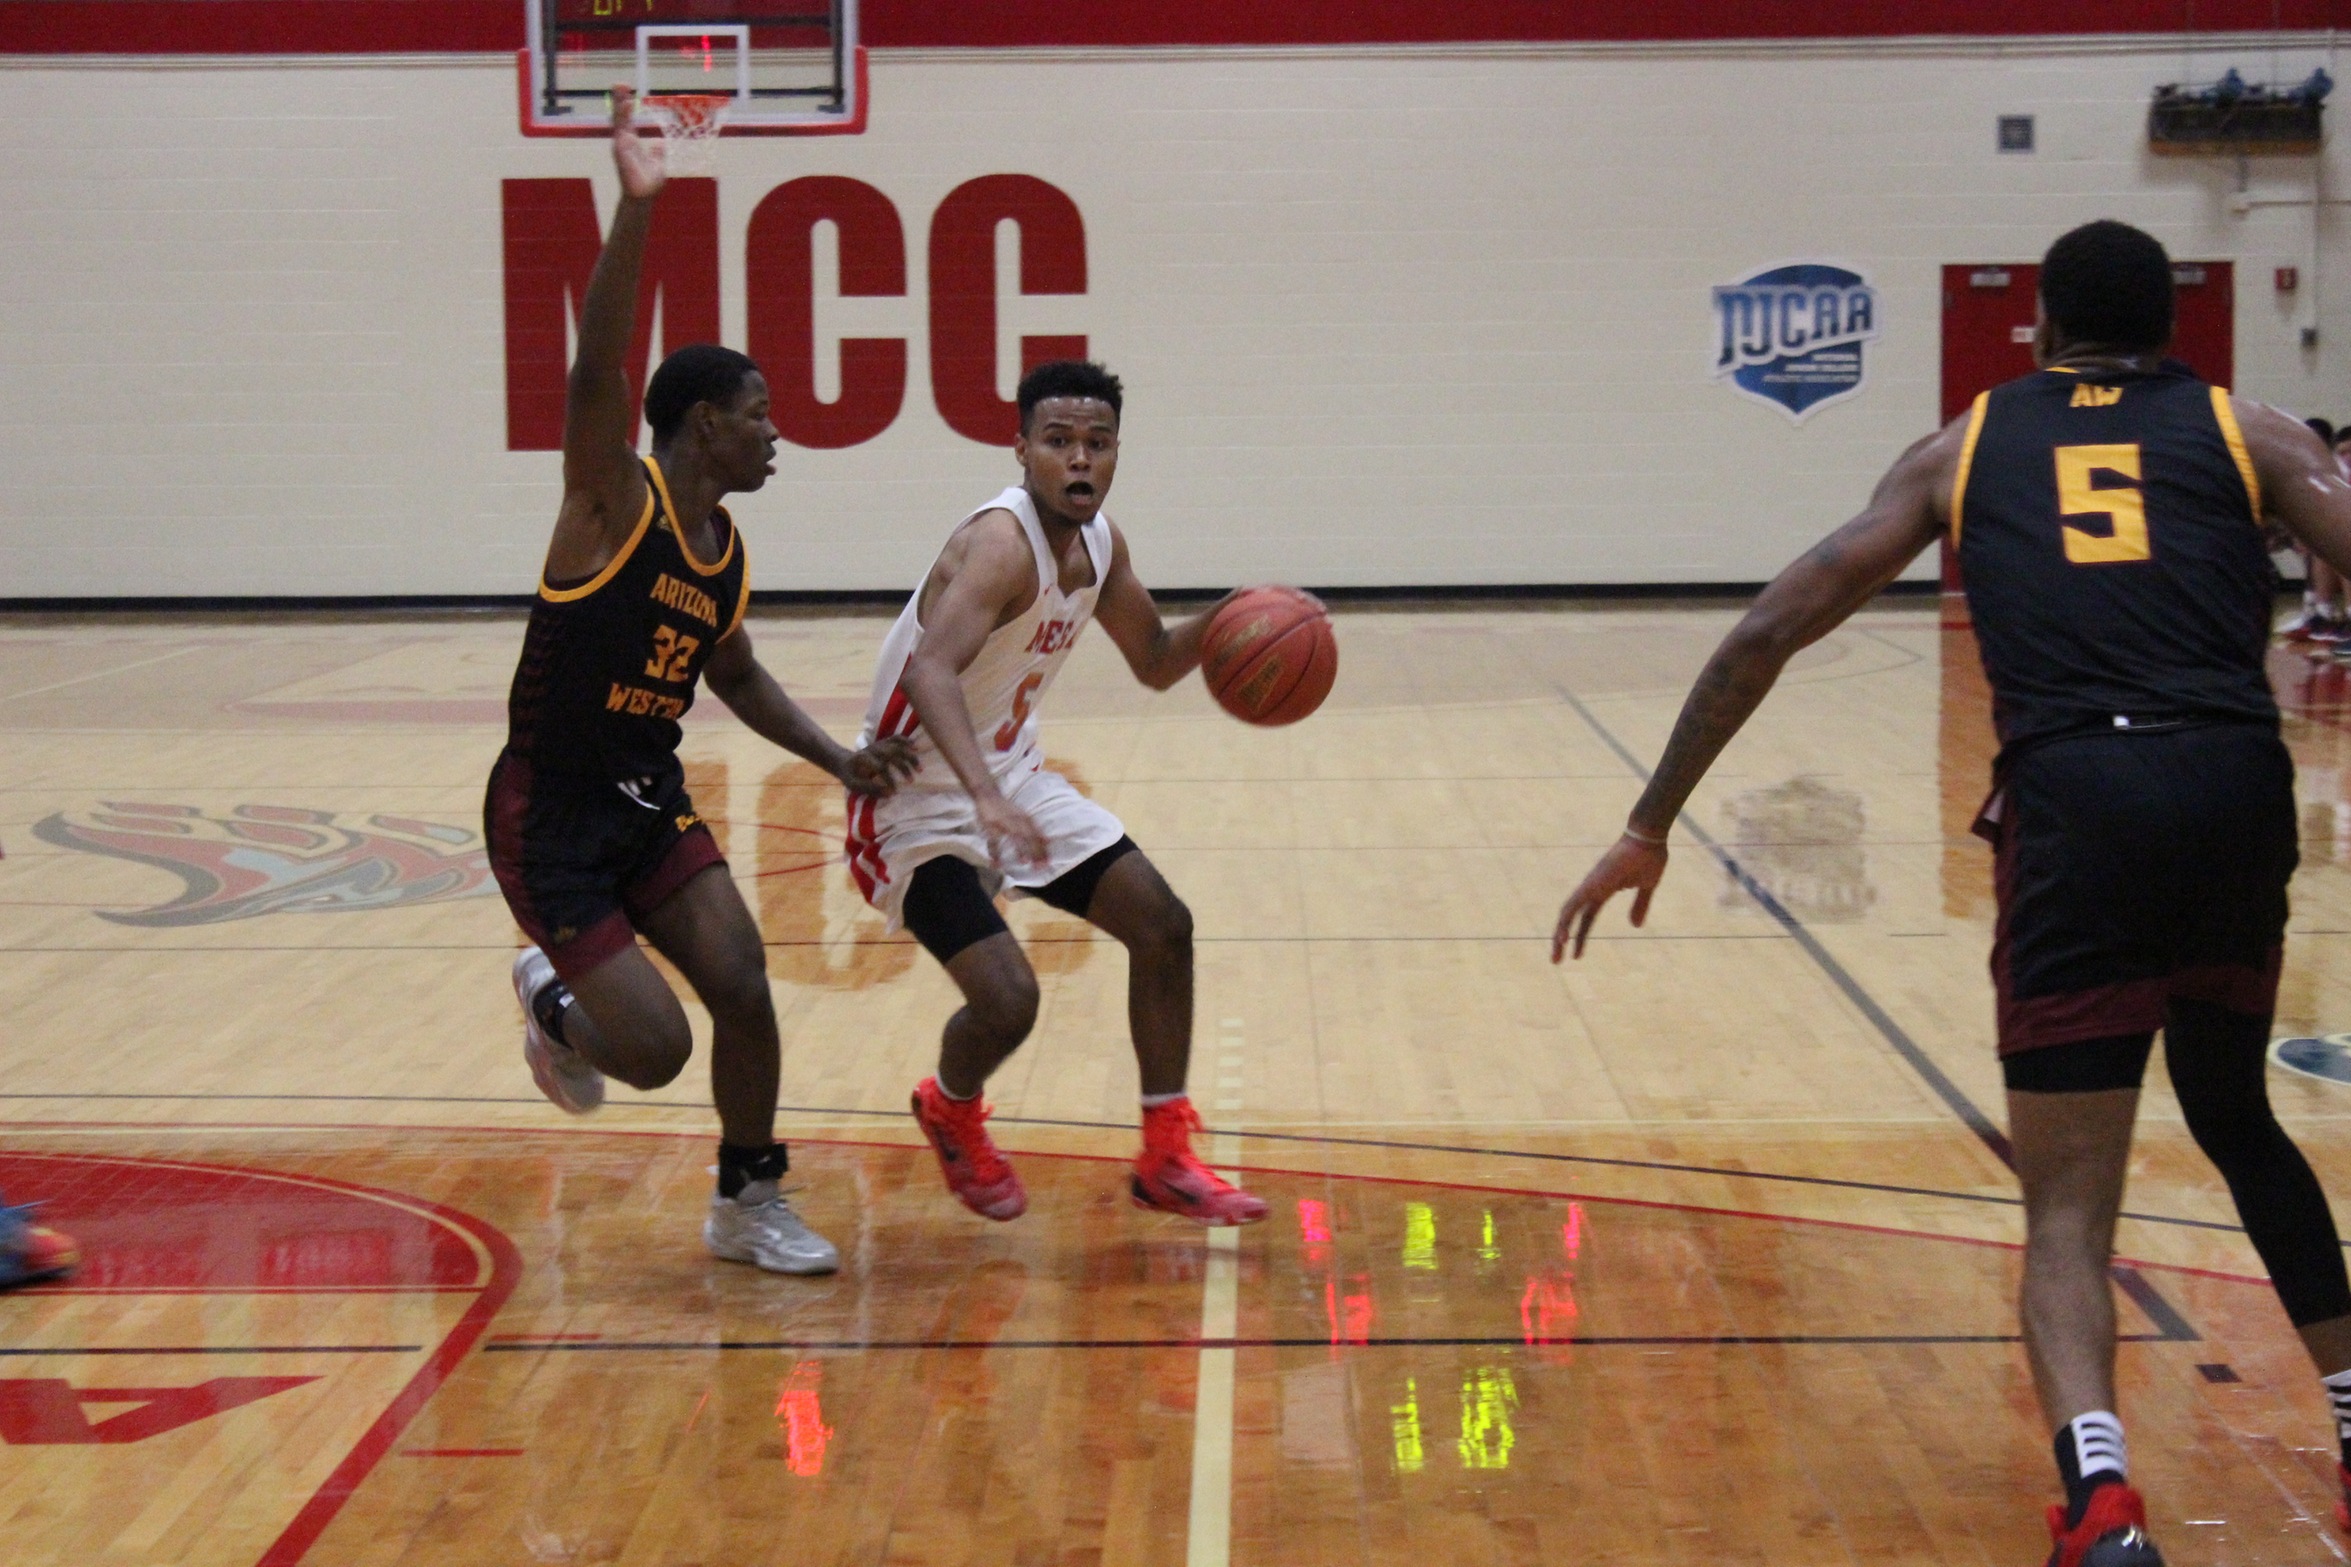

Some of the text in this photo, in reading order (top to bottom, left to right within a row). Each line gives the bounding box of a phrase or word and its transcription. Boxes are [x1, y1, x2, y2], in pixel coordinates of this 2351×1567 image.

[502, 174, 1088, 449] MCC
[1714, 292, 1873, 366] NJCAA
[2054, 443, 2151, 563] 5
[644, 624, 700, 682] 32
[994, 671, 1044, 752] 5
